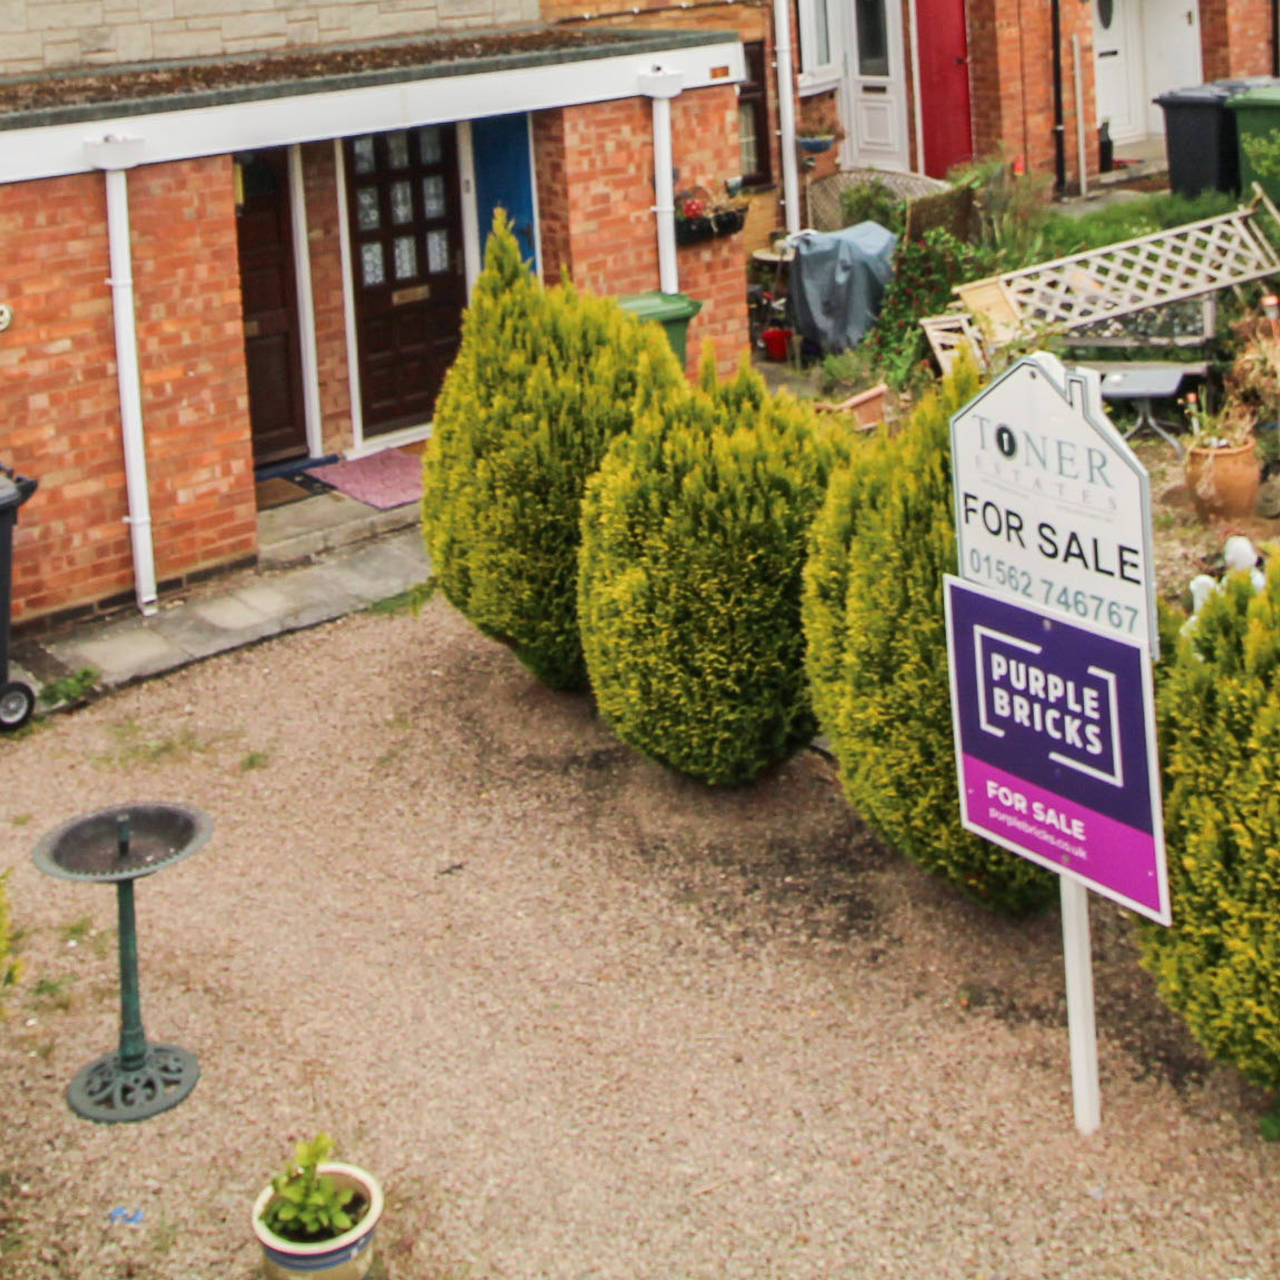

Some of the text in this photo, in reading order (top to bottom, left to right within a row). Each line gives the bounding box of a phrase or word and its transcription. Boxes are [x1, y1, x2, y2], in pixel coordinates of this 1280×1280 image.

[963, 492, 1142, 585] FOR SALE
[969, 548, 1140, 634] 01562 746767
[990, 652, 1101, 720] PURPLE
[993, 687, 1103, 755] BRICKS
[986, 779, 1087, 841] FOR SALE
